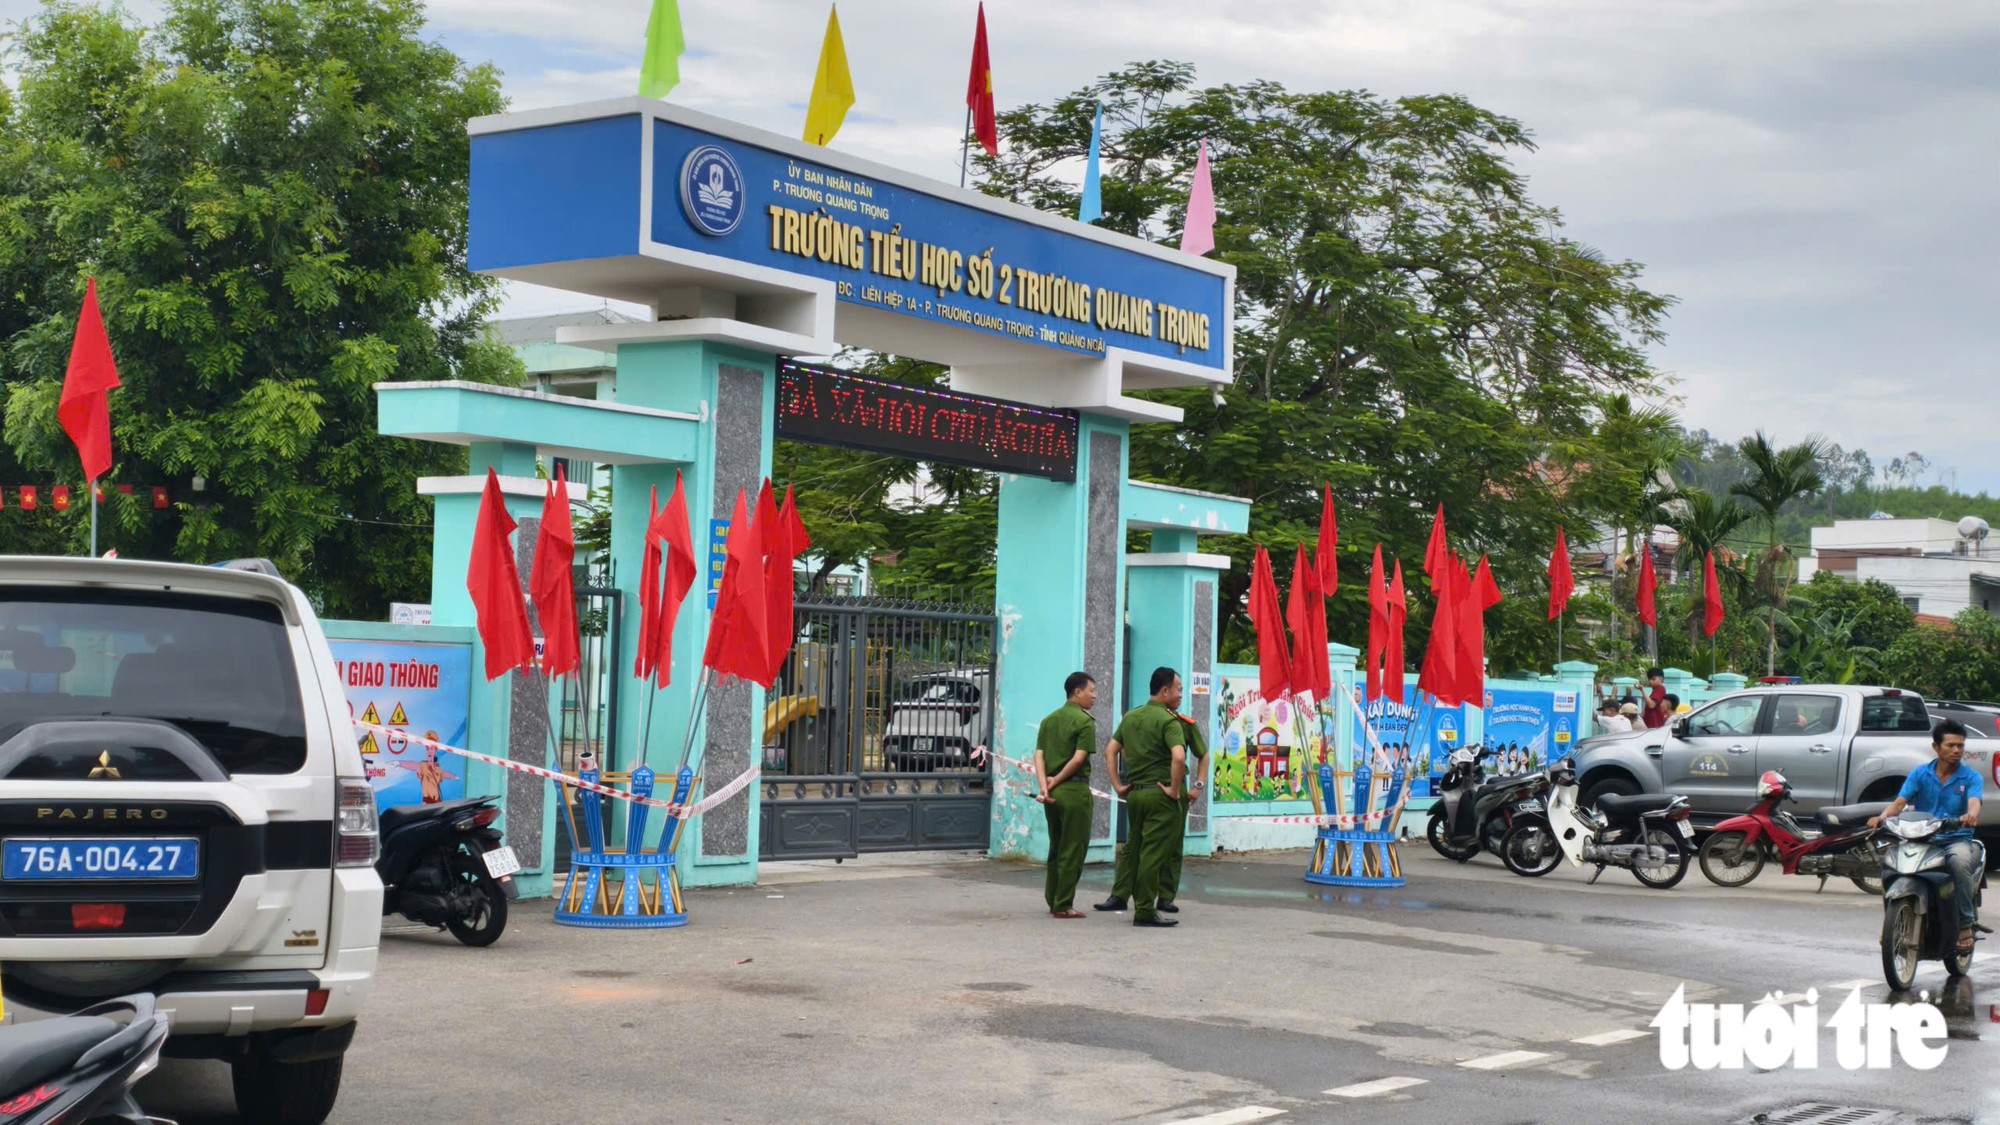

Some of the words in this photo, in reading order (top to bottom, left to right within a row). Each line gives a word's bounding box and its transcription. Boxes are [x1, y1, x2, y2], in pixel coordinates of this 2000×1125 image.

[788, 160, 801, 179] ỦY
[804, 169, 824, 185] BAN
[826, 176, 851, 193] NHÂN
[854, 182, 873, 198] DÂN
[773, 179, 782, 193] P.
[784, 182, 823, 203] TRƯƠNG
[825, 193, 857, 212] QUANG
[860, 201, 889, 220] TRỌNG
[769, 204, 864, 270] TRƯỜNG
[870, 222, 917, 281] TIỂU
[921, 242, 962, 298] HỌC
[967, 246, 995, 300] SỐ
[999, 264, 1012, 305] 2
[1016, 267, 1092, 324] TRƯƠNG
[1095, 287, 1153, 338] QUANG
[1156, 303, 1210, 354] TRỌNG
[861, 285, 881, 303] LIÊN
[884, 290, 903, 309] HIỆP
[906, 297, 916, 311] 1A
[925, 301, 933, 315] P.
[936, 303, 972, 324] TRƯƠNG
[973, 312, 1003, 331] QUANG
[1005, 320, 1034, 338] TRỌNG
[1039, 324, 1057, 343] TỈNH
[1059, 329, 1086, 349] QUẢNG
[348, 661, 384, 687] GIAO
[389, 658, 439, 688] THÔNG
[1699, 762, 1717, 771] 114
[37, 808, 168, 820] PAJERO
[20, 846, 181, 872] 76A-004.27
